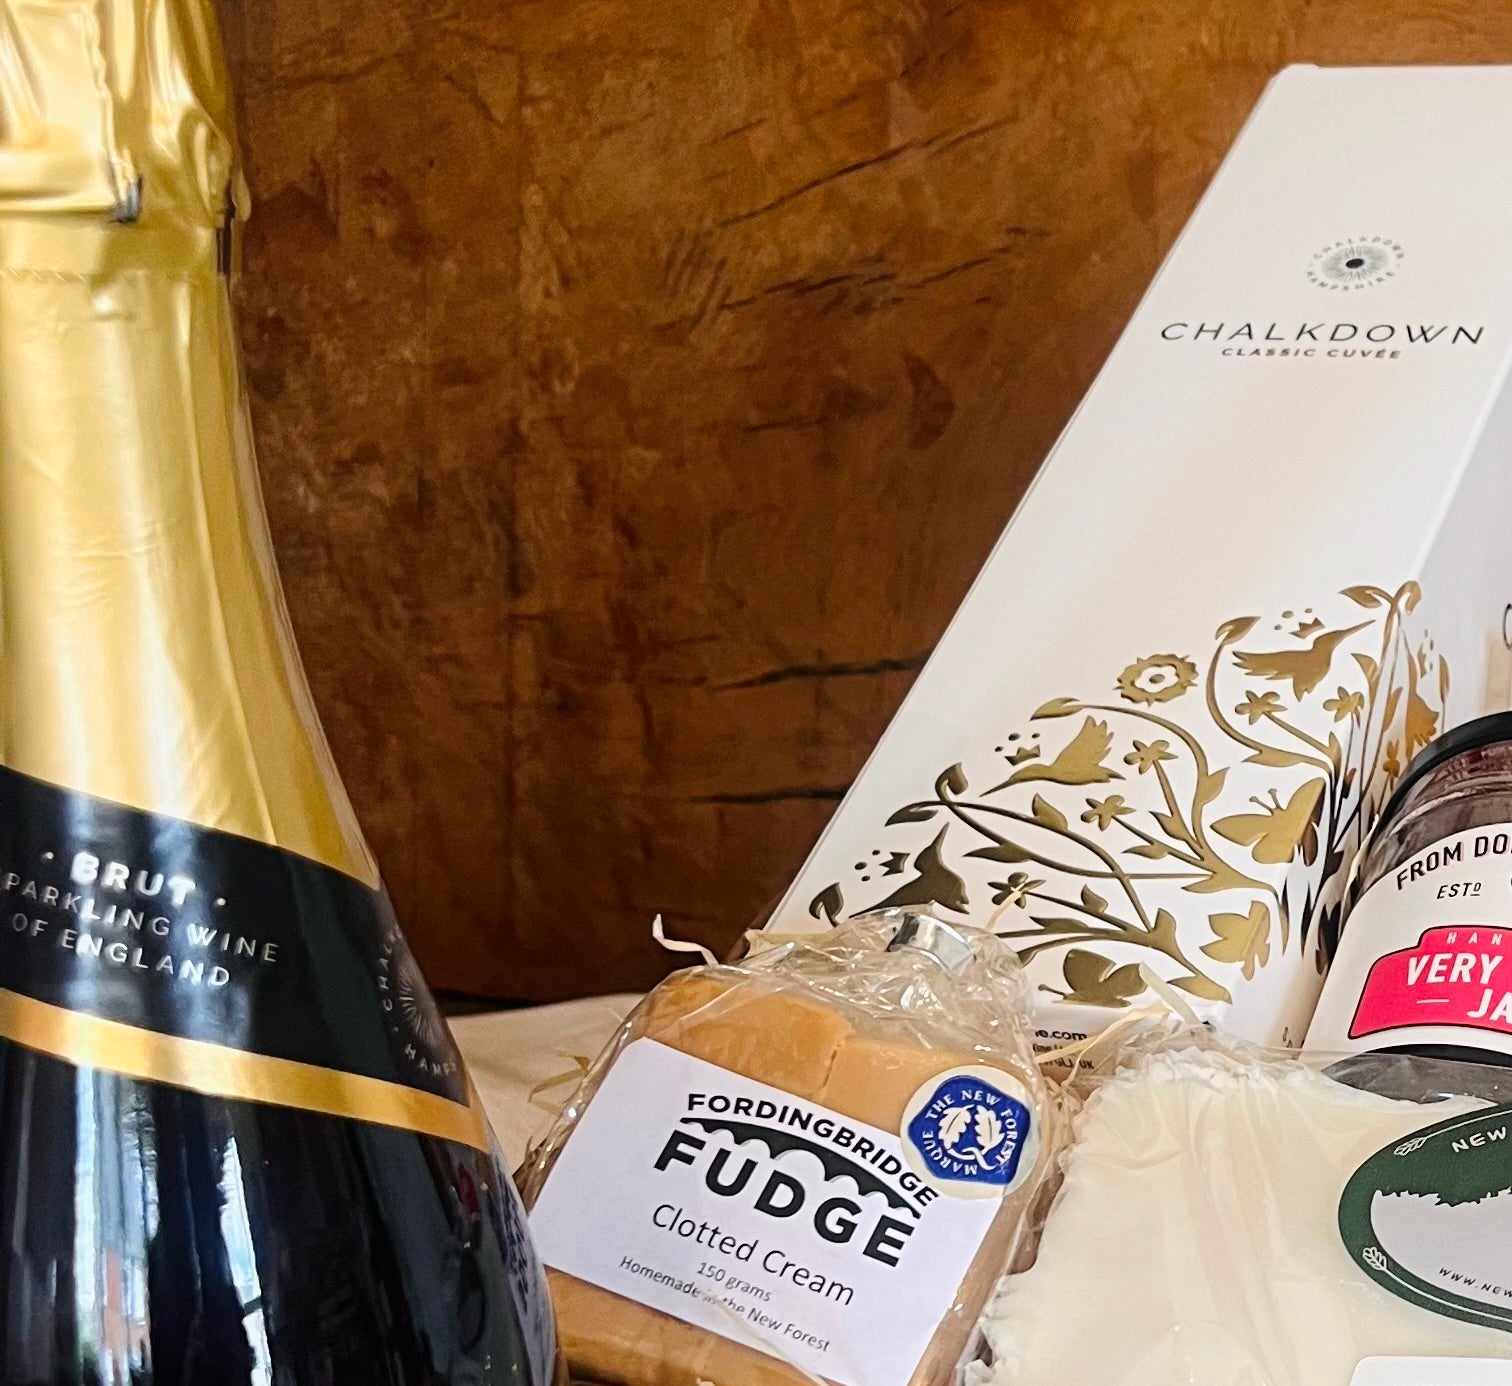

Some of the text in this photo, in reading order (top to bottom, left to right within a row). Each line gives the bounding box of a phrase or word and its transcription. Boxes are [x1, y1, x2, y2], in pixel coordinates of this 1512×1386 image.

[1160, 322, 1485, 345] CHALKDOWN
[1221, 347, 1402, 360] CLASSIC CUVÉE
[70, 851, 197, 908] BRUT
[1396, 841, 1464, 891] FROM
[2, 872, 280, 964] PARKLING WINE
[12, 912, 231, 987] OF ENGLAND
[1407, 951, 1505, 987] VERY
[687, 1092, 940, 1209] FORDINGBRIDGE
[921, 1129, 979, 1175] MARQUE
[925, 1089, 1019, 1166] THE NEW FOREST
[1451, 1124, 1508, 1154] NEW
[653, 1128, 916, 1269] FUDGE
[652, 1202, 856, 1308] Clotted Cream
[696, 1261, 727, 1284] 150
[724, 1275, 774, 1303] grams
[618, 1255, 703, 1299] Homemade
[746, 1306, 782, 1333] New
[783, 1322, 832, 1353] Forest
